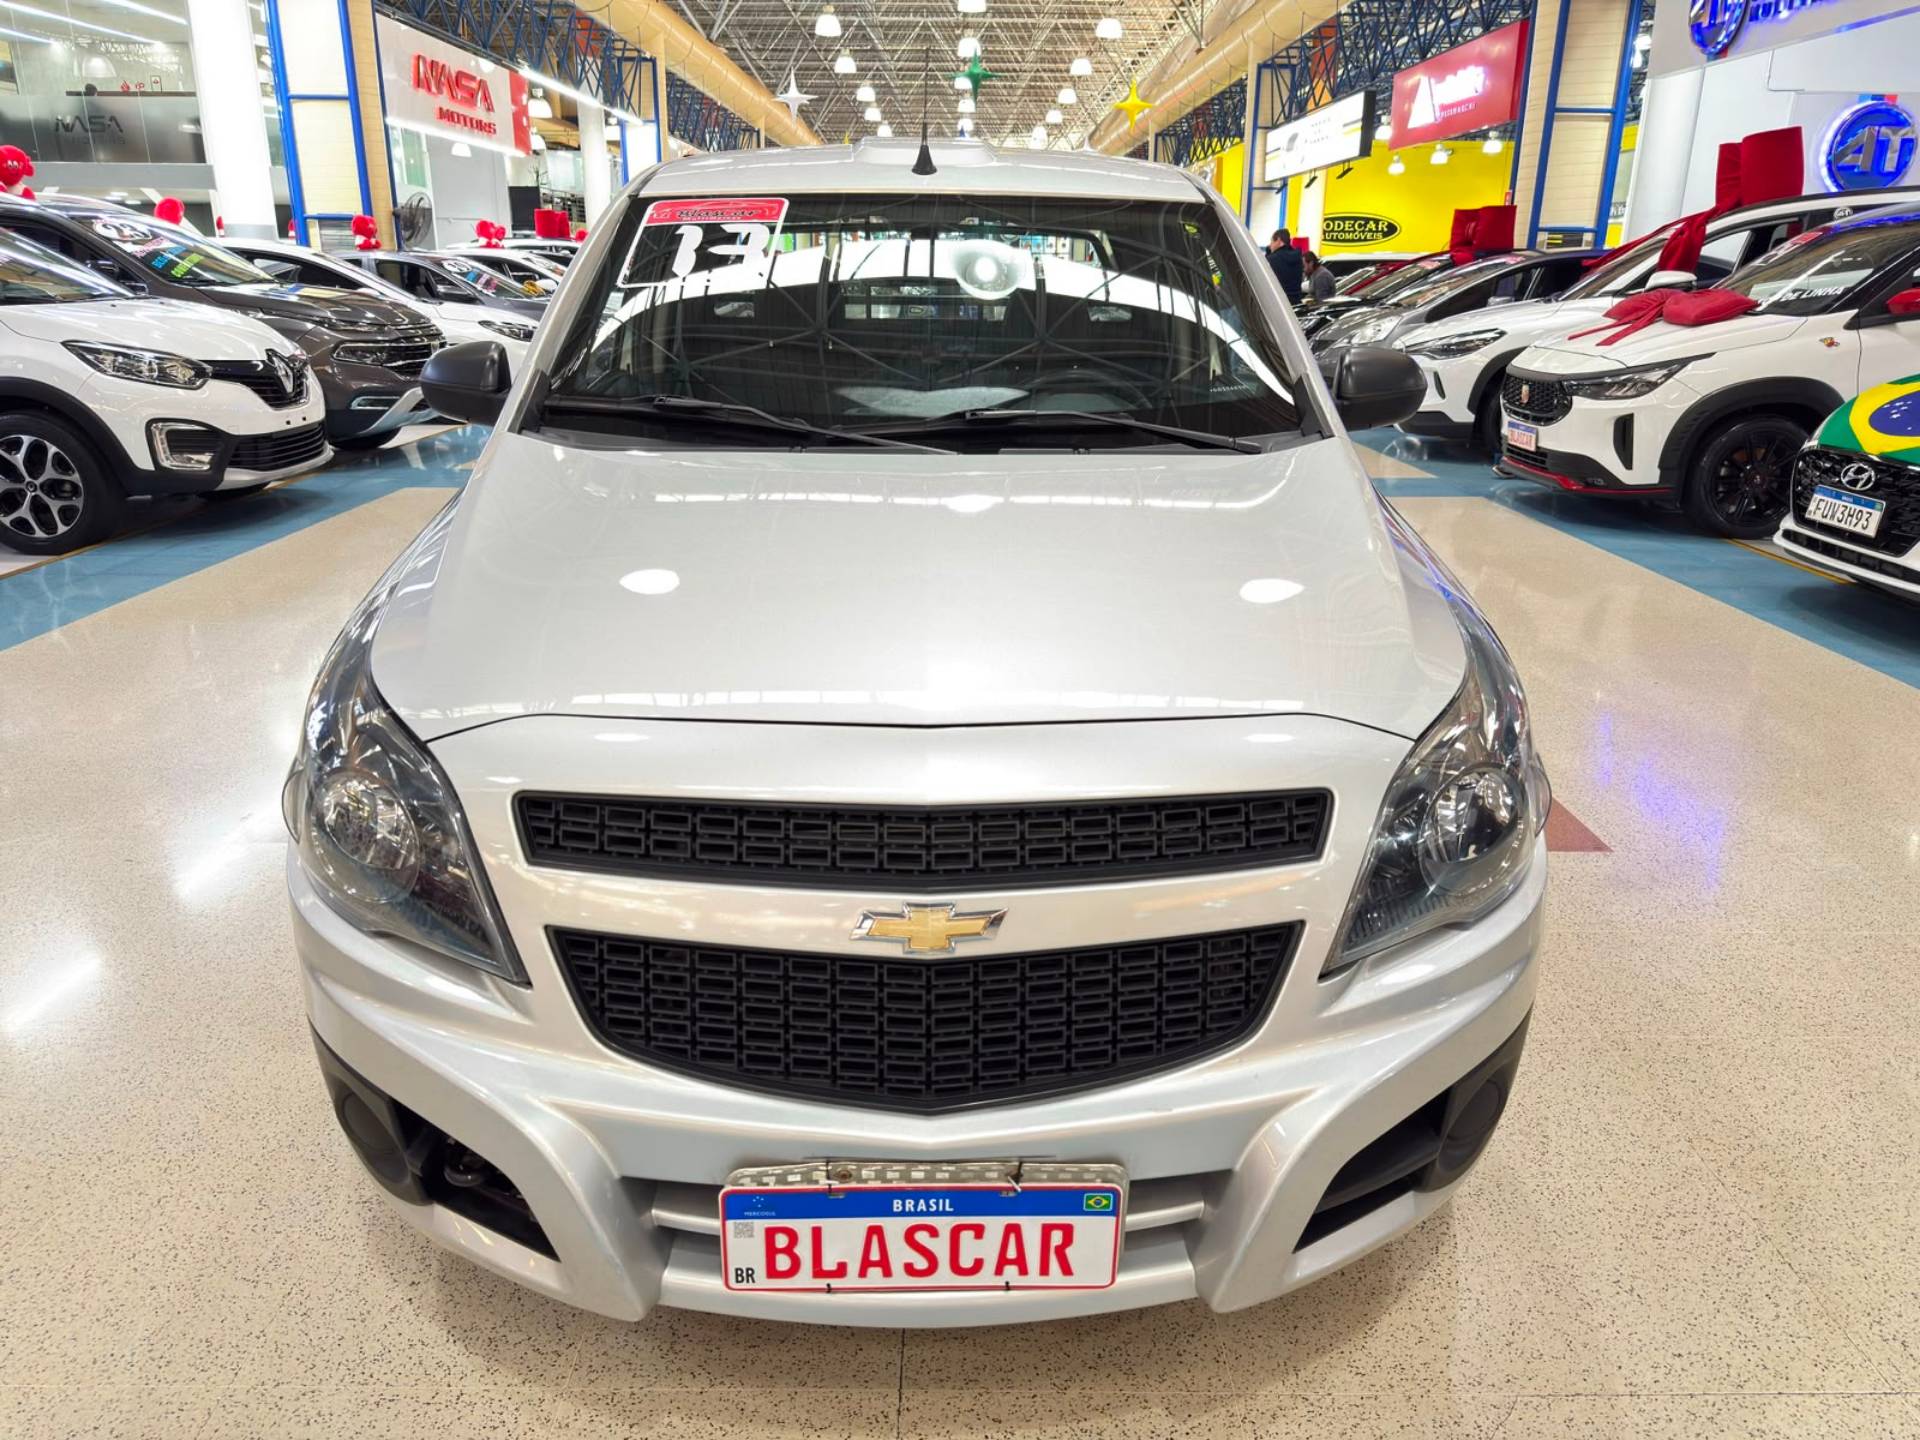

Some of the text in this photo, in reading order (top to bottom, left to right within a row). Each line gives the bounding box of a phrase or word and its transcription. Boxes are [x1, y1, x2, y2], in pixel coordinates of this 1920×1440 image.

[412, 54, 495, 113] NASA
[436, 106, 497, 135] MOTORS
[1323, 220, 1388, 232] ODECAR
[893, 1198, 954, 1212] BRASIL
[764, 1222, 1074, 1280] BLASCAR
[734, 1267, 756, 1284] BR
